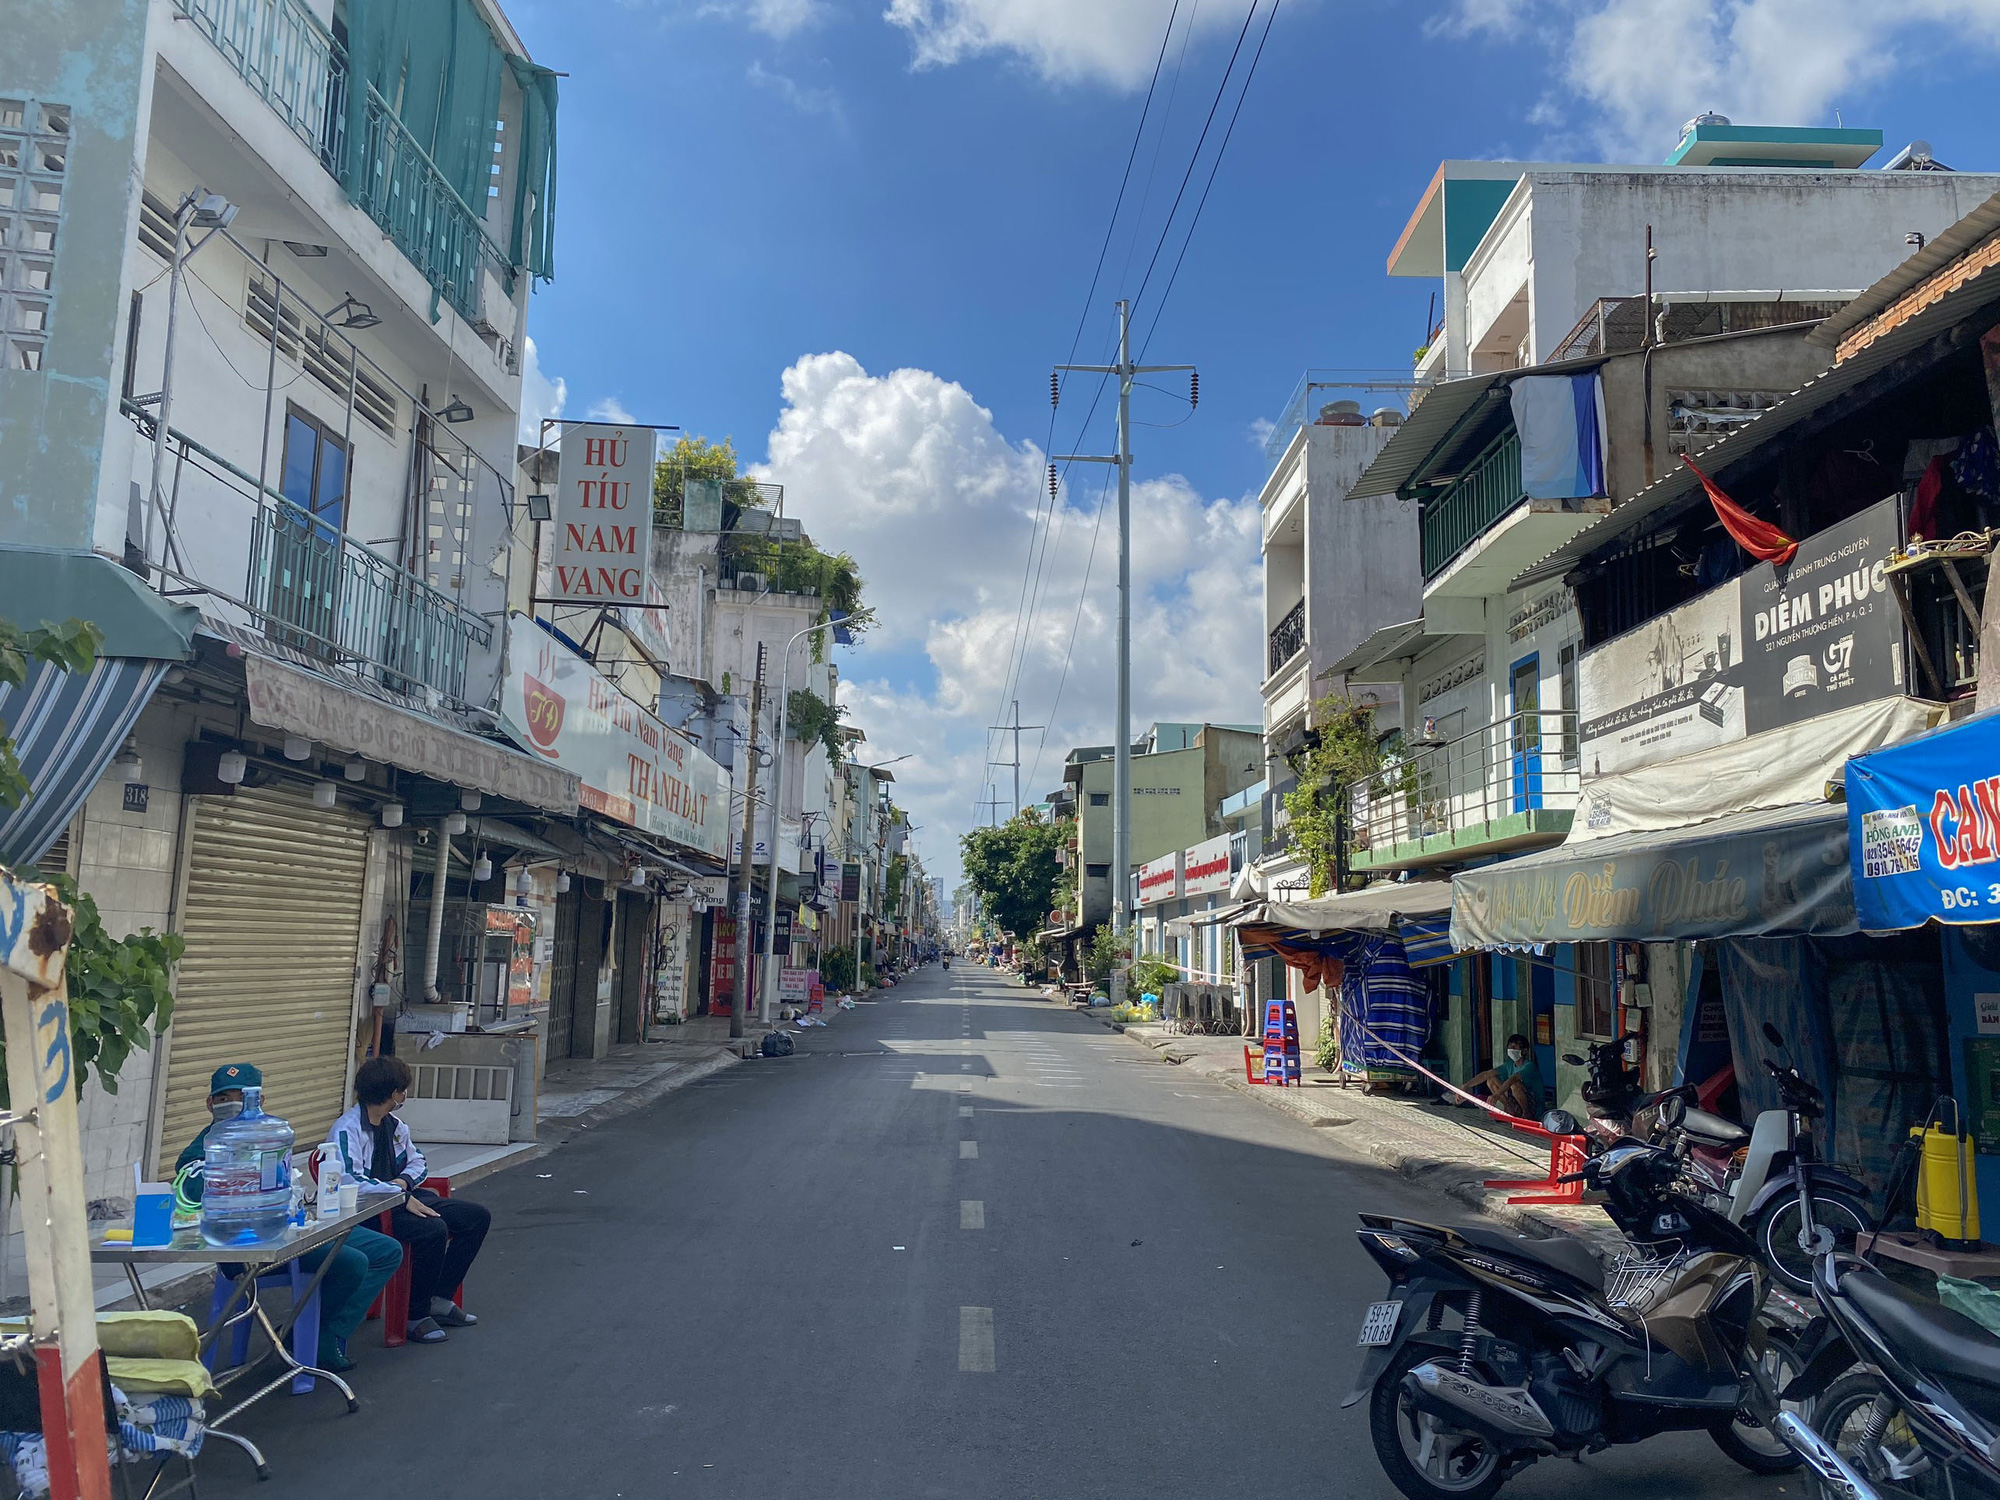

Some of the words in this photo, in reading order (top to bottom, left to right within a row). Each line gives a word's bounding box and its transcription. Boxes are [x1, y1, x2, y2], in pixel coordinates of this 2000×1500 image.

[584, 430, 629, 468] HỦ
[577, 472, 631, 510] TÍU
[564, 523, 638, 554] NAM
[1813, 553, 1837, 571] TRUNG
[1838, 537, 1869, 559] NGUYÊN
[556, 565, 642, 598] VANG
[1819, 558, 1887, 616] PHÚC
[1765, 640, 1776, 652] 321
[1868, 603, 1873, 613] 3
[635, 709, 659, 751] Nam
[661, 727, 684, 772] Vang
[126, 787, 147, 804] 318
[627, 752, 682, 817] THÀNH
[682, 784, 708, 831] ĐẠT
[1866, 824, 1890, 844] HỒNG
[1892, 823, 1920, 838] ANH
[1647, 857, 1748, 938] Phúc
[1941, 886, 1979, 909] ĐC:
[1370, 1304, 1396, 1323] 59-F1
[1360, 1323, 1392, 1343] 510.68
